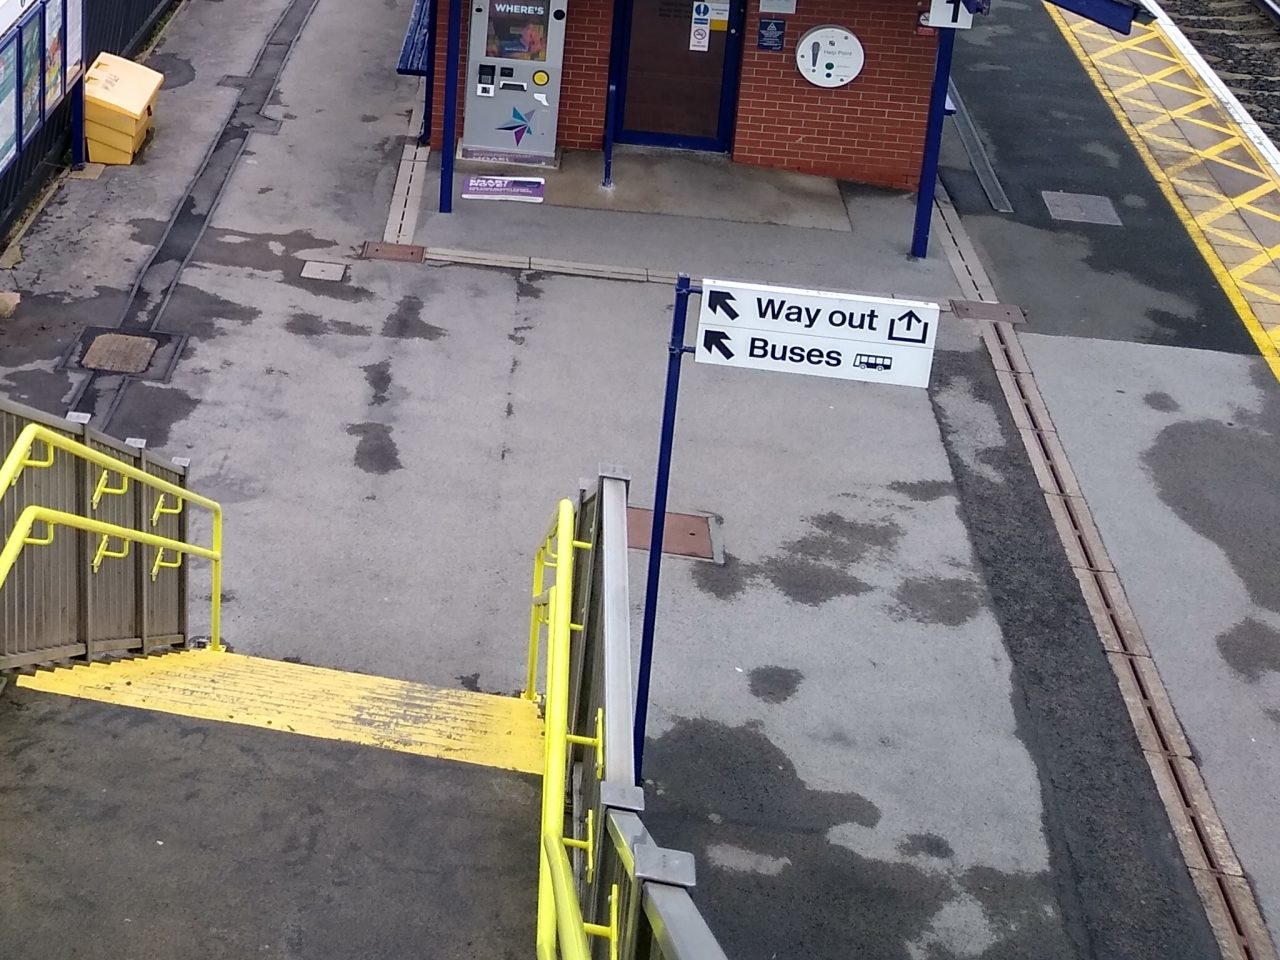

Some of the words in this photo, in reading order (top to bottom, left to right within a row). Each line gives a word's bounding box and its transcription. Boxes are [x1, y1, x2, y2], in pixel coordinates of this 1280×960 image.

[494, 3, 545, 16] WHERE'S
[756, 297, 822, 329] Way
[828, 308, 878, 331] out
[749, 337, 842, 367] Buses
